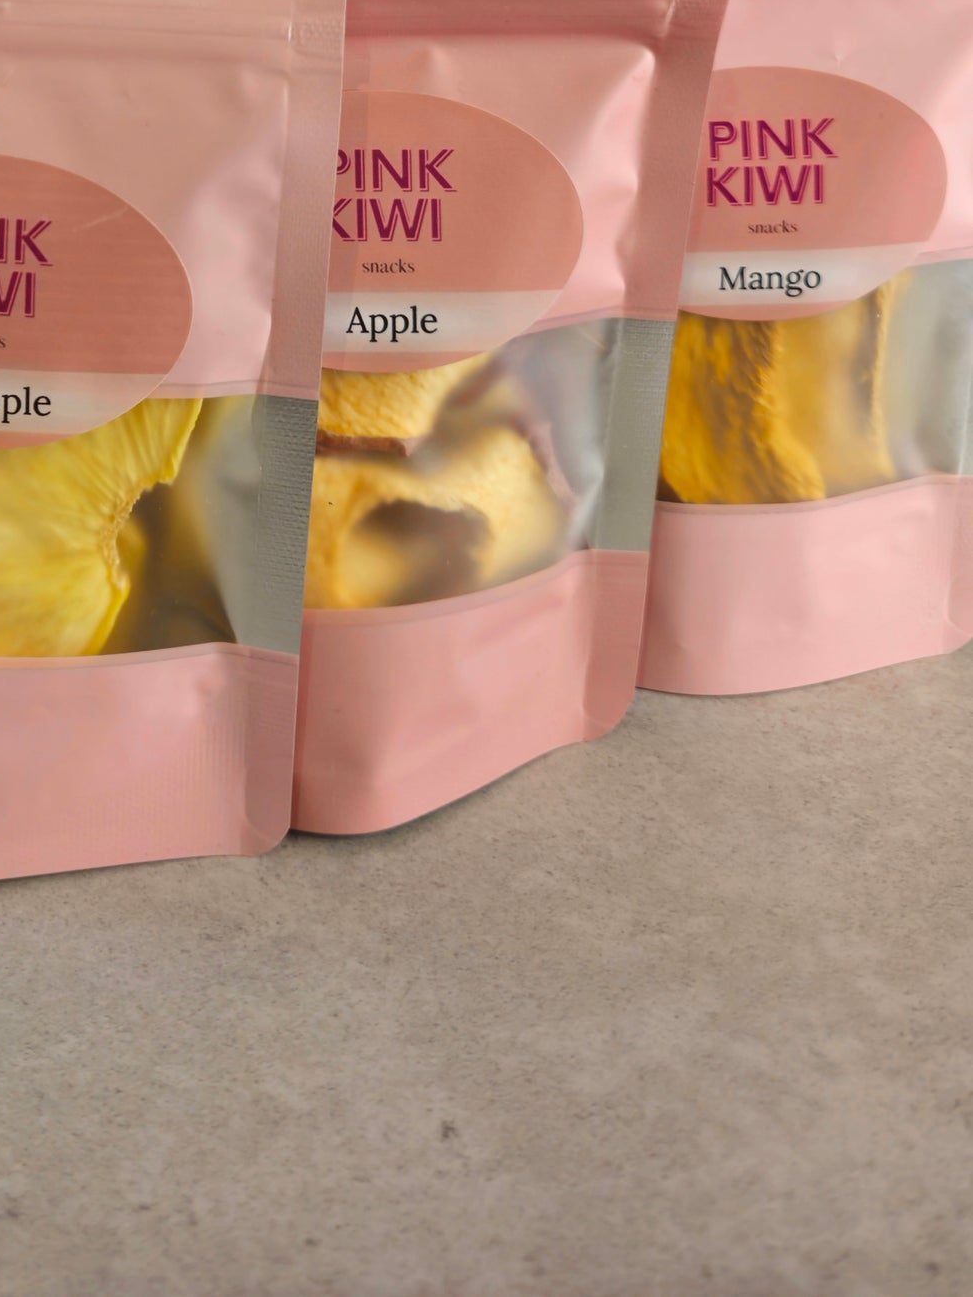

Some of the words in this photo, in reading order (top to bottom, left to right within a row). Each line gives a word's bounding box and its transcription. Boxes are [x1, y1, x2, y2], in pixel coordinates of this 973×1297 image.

[708, 118, 838, 161] PINK
[706, 164, 824, 207] KIWI
[747, 220, 798, 234] snacks
[361, 259, 416, 274] snacks
[718, 266, 822, 298] Mango
[345, 305, 438, 343] Apple
